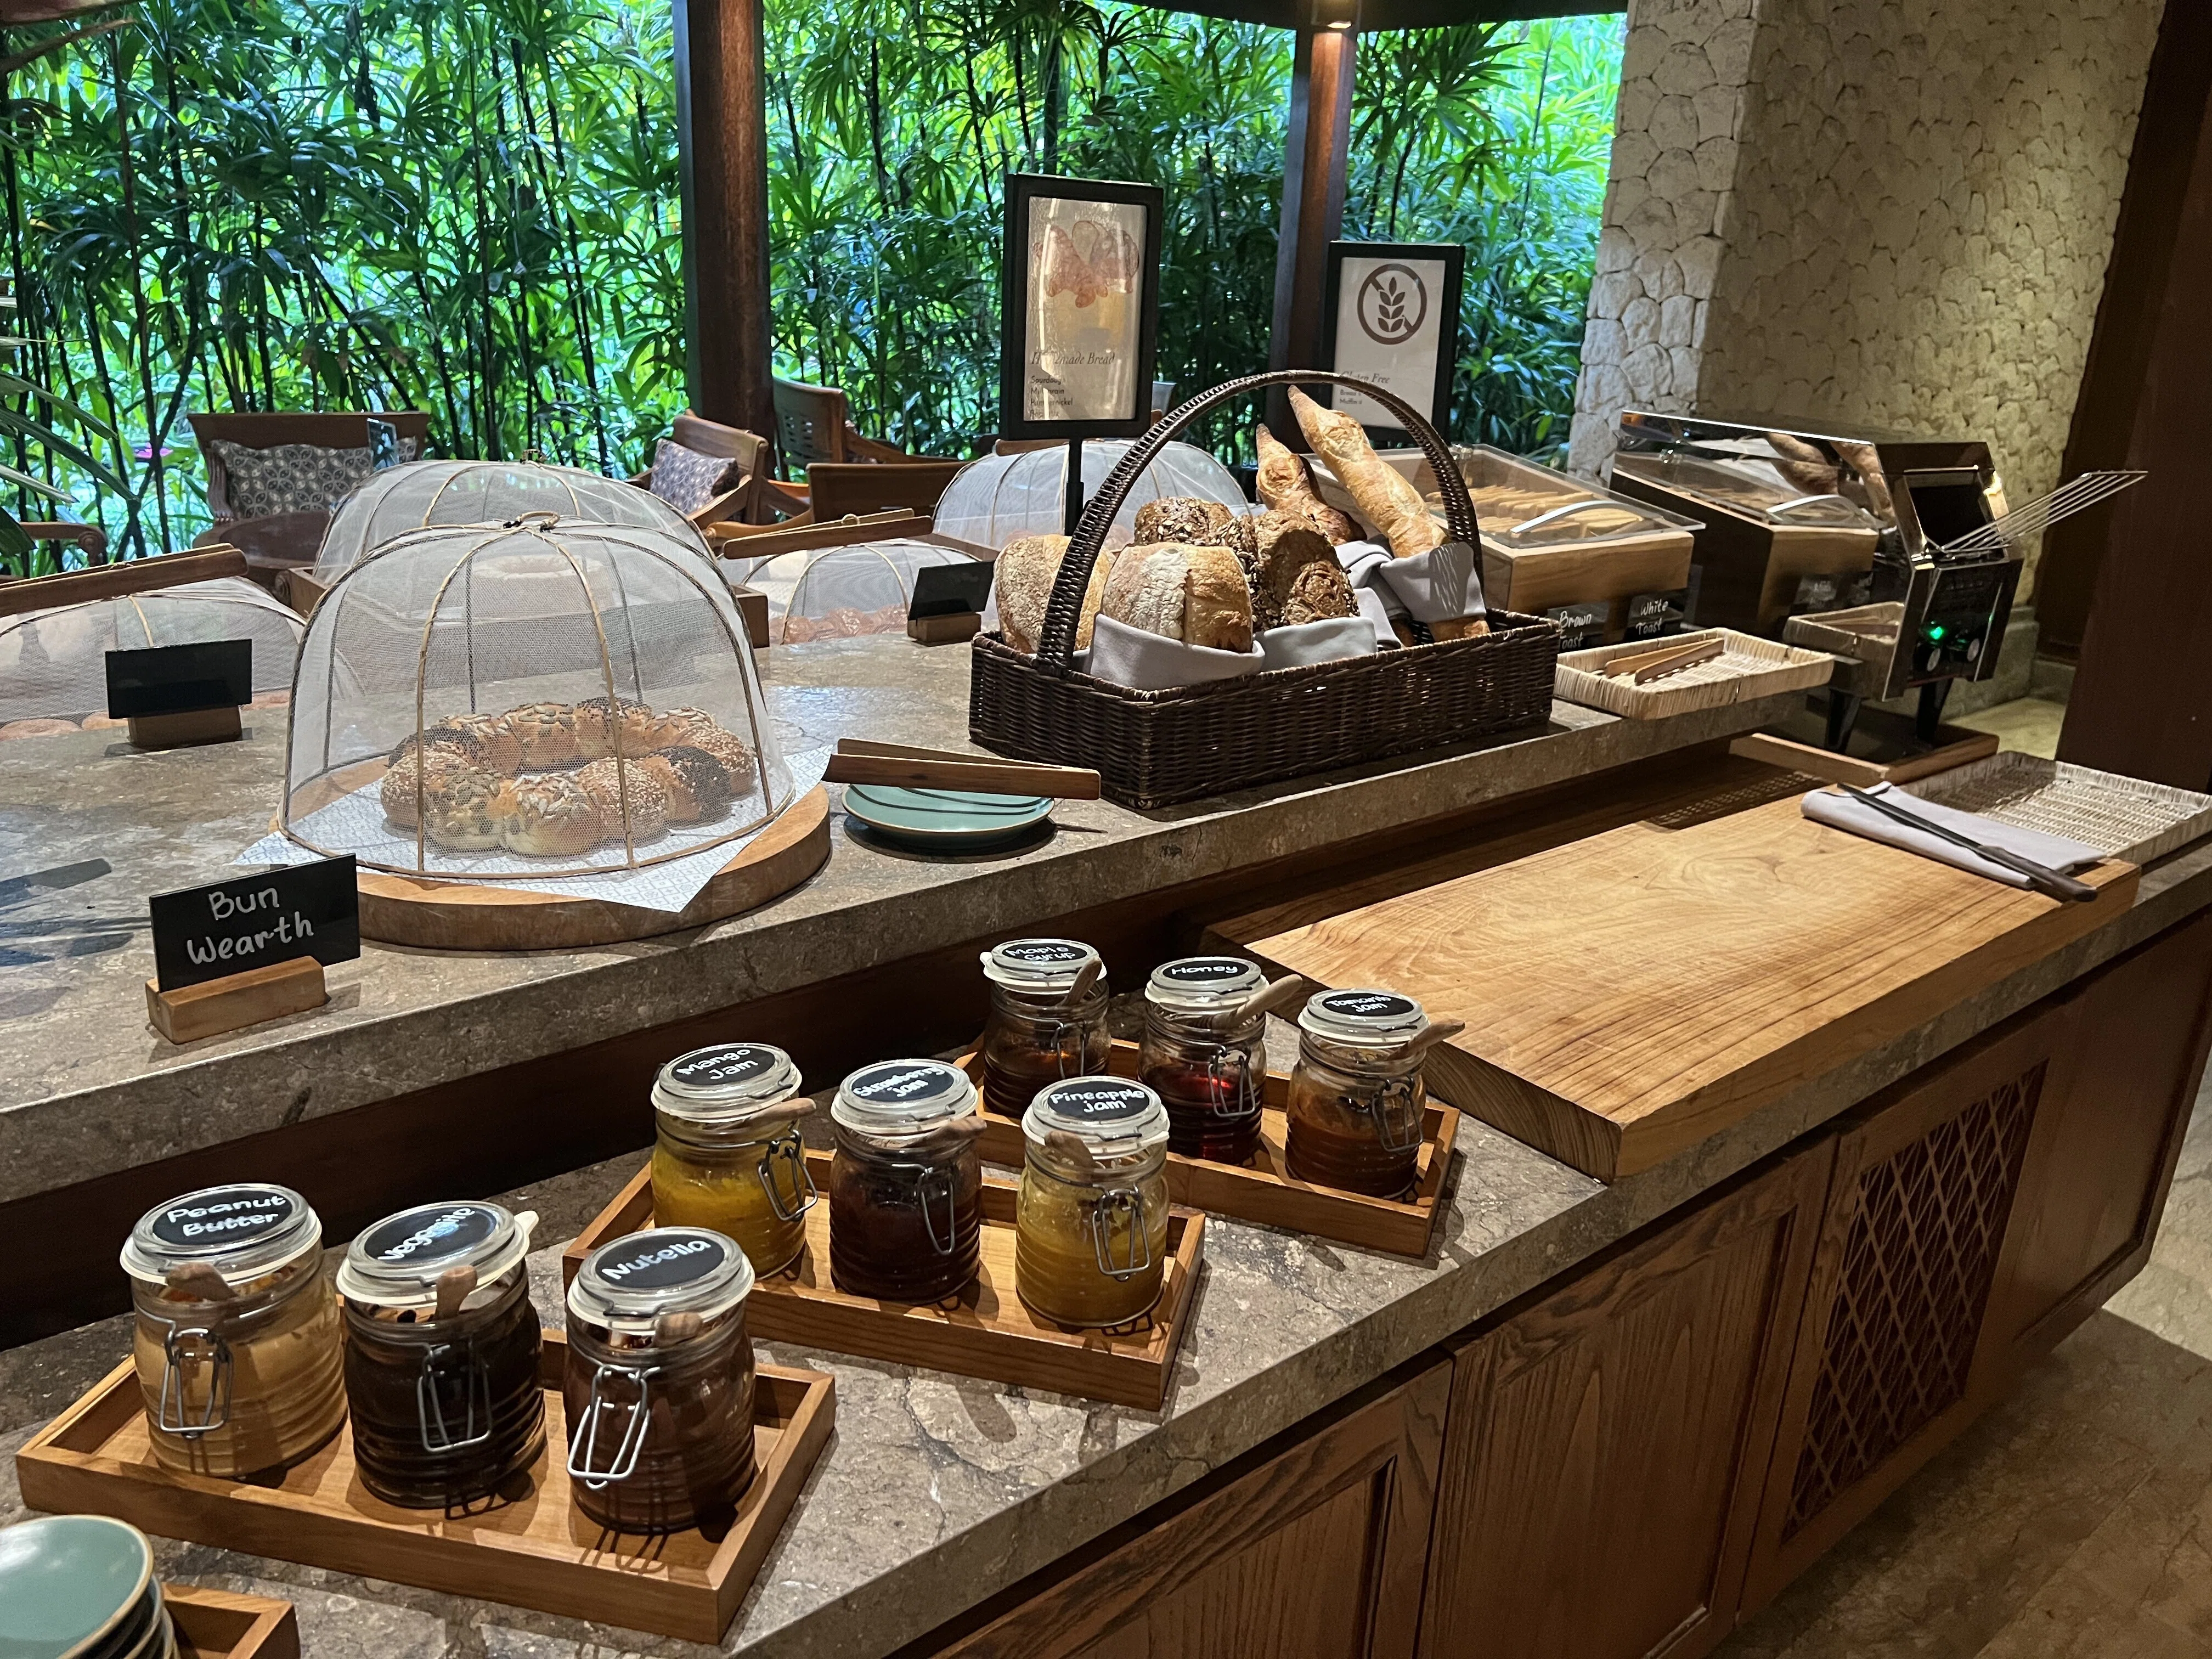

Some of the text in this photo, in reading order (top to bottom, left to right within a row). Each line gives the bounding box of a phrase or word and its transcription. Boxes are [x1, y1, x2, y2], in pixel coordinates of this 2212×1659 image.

[1086, 352, 1115, 365] Bread
[1372, 373, 1390, 383] Free
[1640, 599, 1668, 616] White
[1559, 611, 1592, 628] Brown
[1635, 618, 1662, 635] Toast
[208, 887, 280, 921] Bun
[187, 911, 314, 965] Wearth
[1005, 946, 1069, 956] Maple
[1171, 966, 1238, 975] Honey
[676, 1049, 751, 1075] Mango
[853, 1066, 945, 1096] Strawberry
[1049, 1088, 1146, 1104] Pineapple
[1084, 1100, 1127, 1113] jam
[167, 1195, 286, 1223] Peanut
[183, 1213, 279, 1237] Butter
[602, 1240, 712, 1280] Nutella
